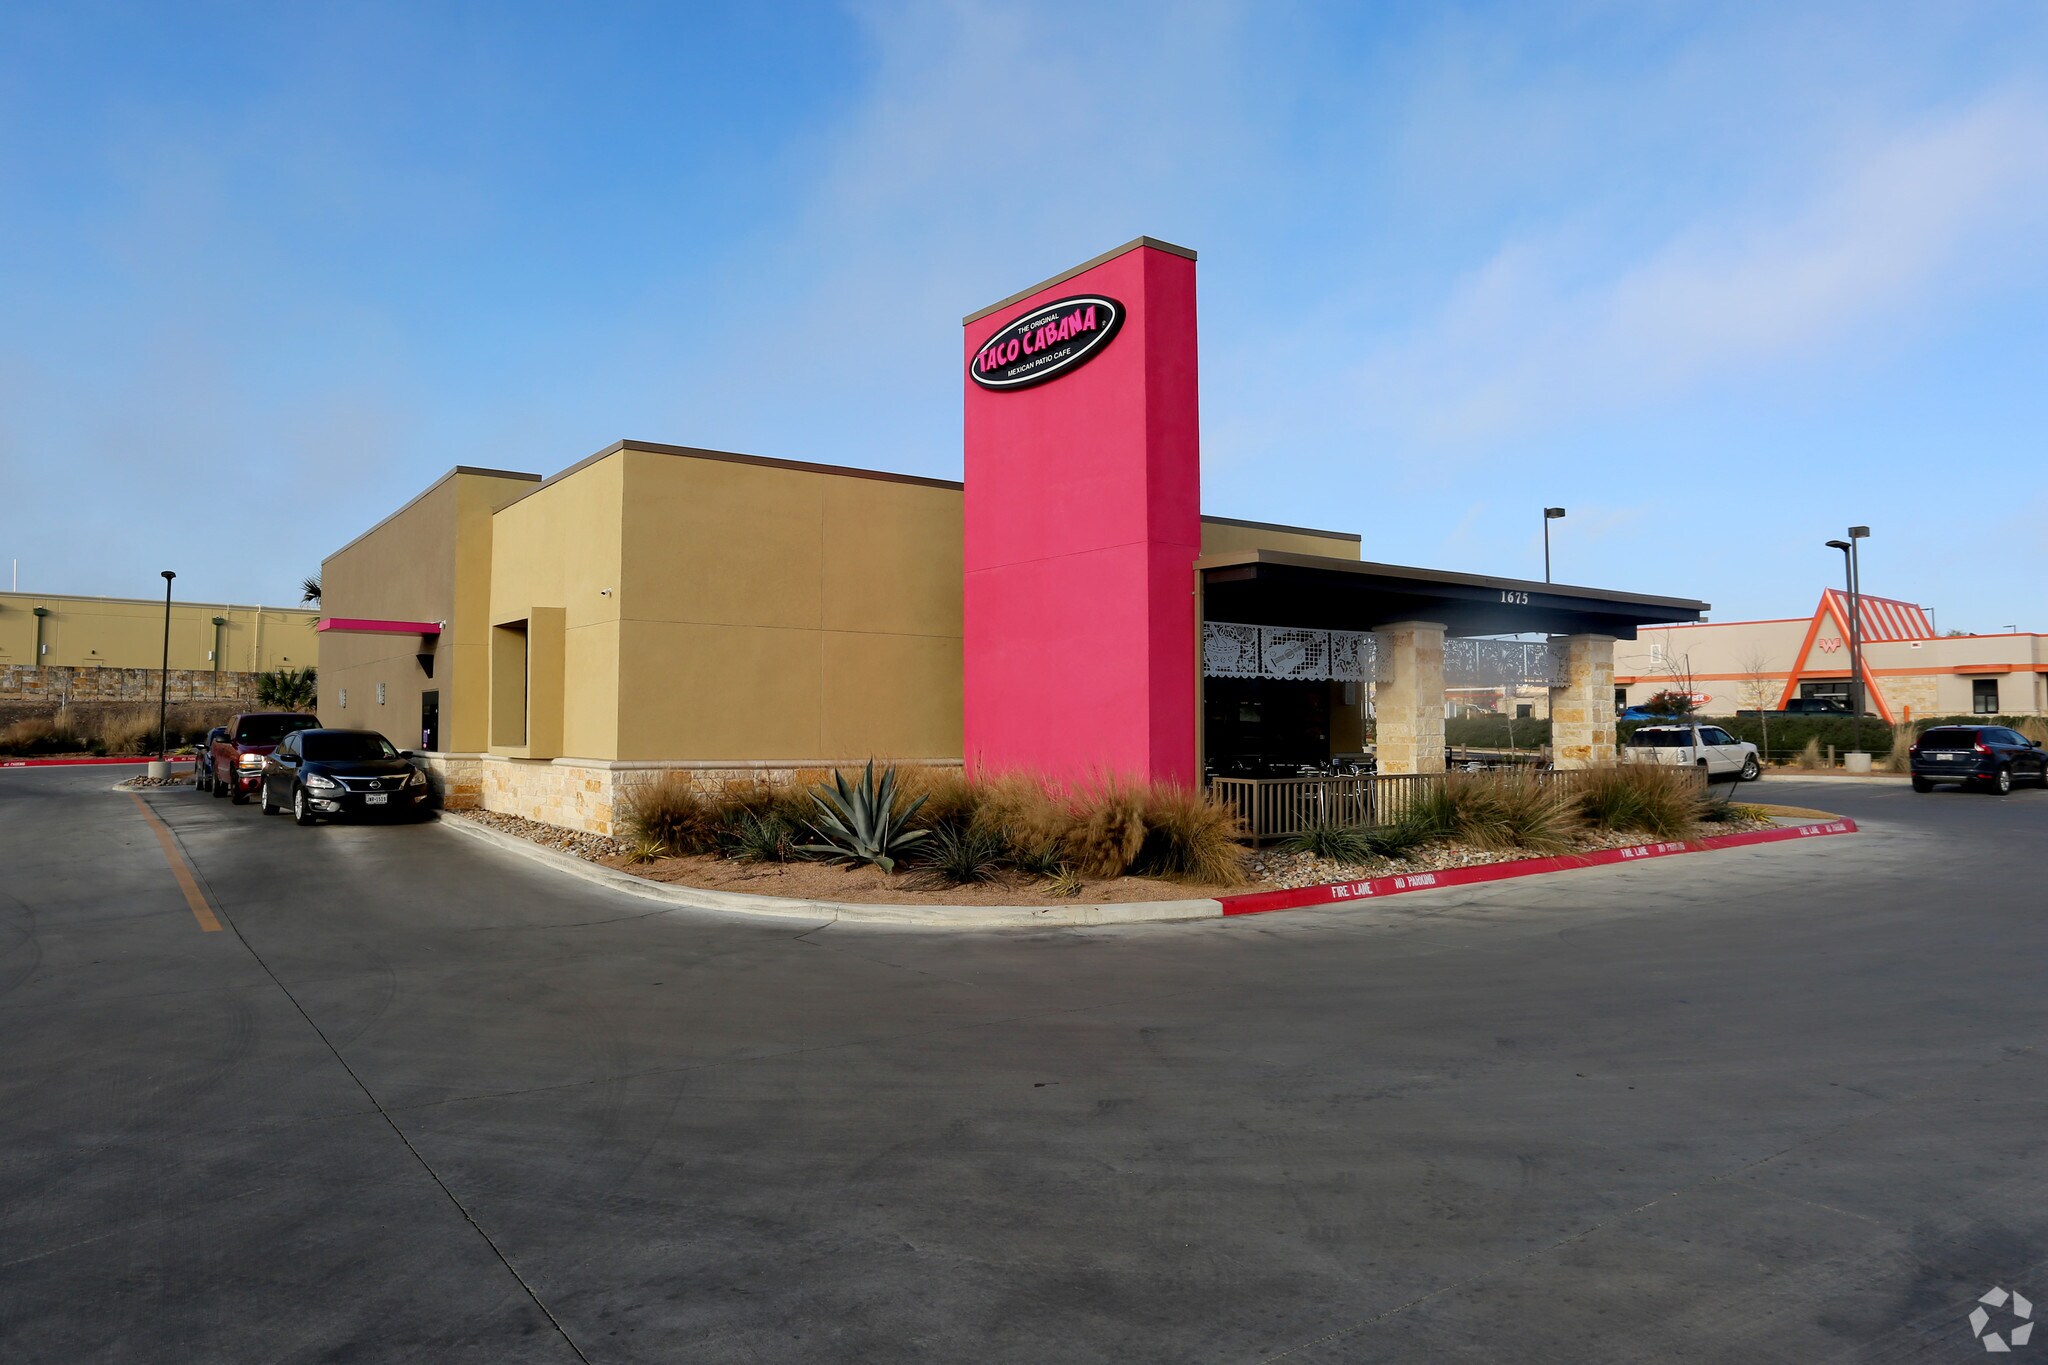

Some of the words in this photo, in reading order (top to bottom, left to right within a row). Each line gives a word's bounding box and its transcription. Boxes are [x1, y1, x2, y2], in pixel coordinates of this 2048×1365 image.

[1017, 324, 1030, 335] THE
[1030, 313, 1060, 331] ORIGINAL
[977, 338, 1020, 373] TACO
[1022, 305, 1098, 355] CABANA
[1007, 361, 1035, 377] MEXICAN
[1035, 354, 1053, 367] PATIO
[1053, 347, 1072, 360] CAFE
[1500, 590, 1529, 605] 1675
[1331, 885, 1350, 899] FIRE
[1352, 881, 1374, 896] LANE
[1394, 877, 1406, 889] NO
[1406, 873, 1436, 887] PARKING
